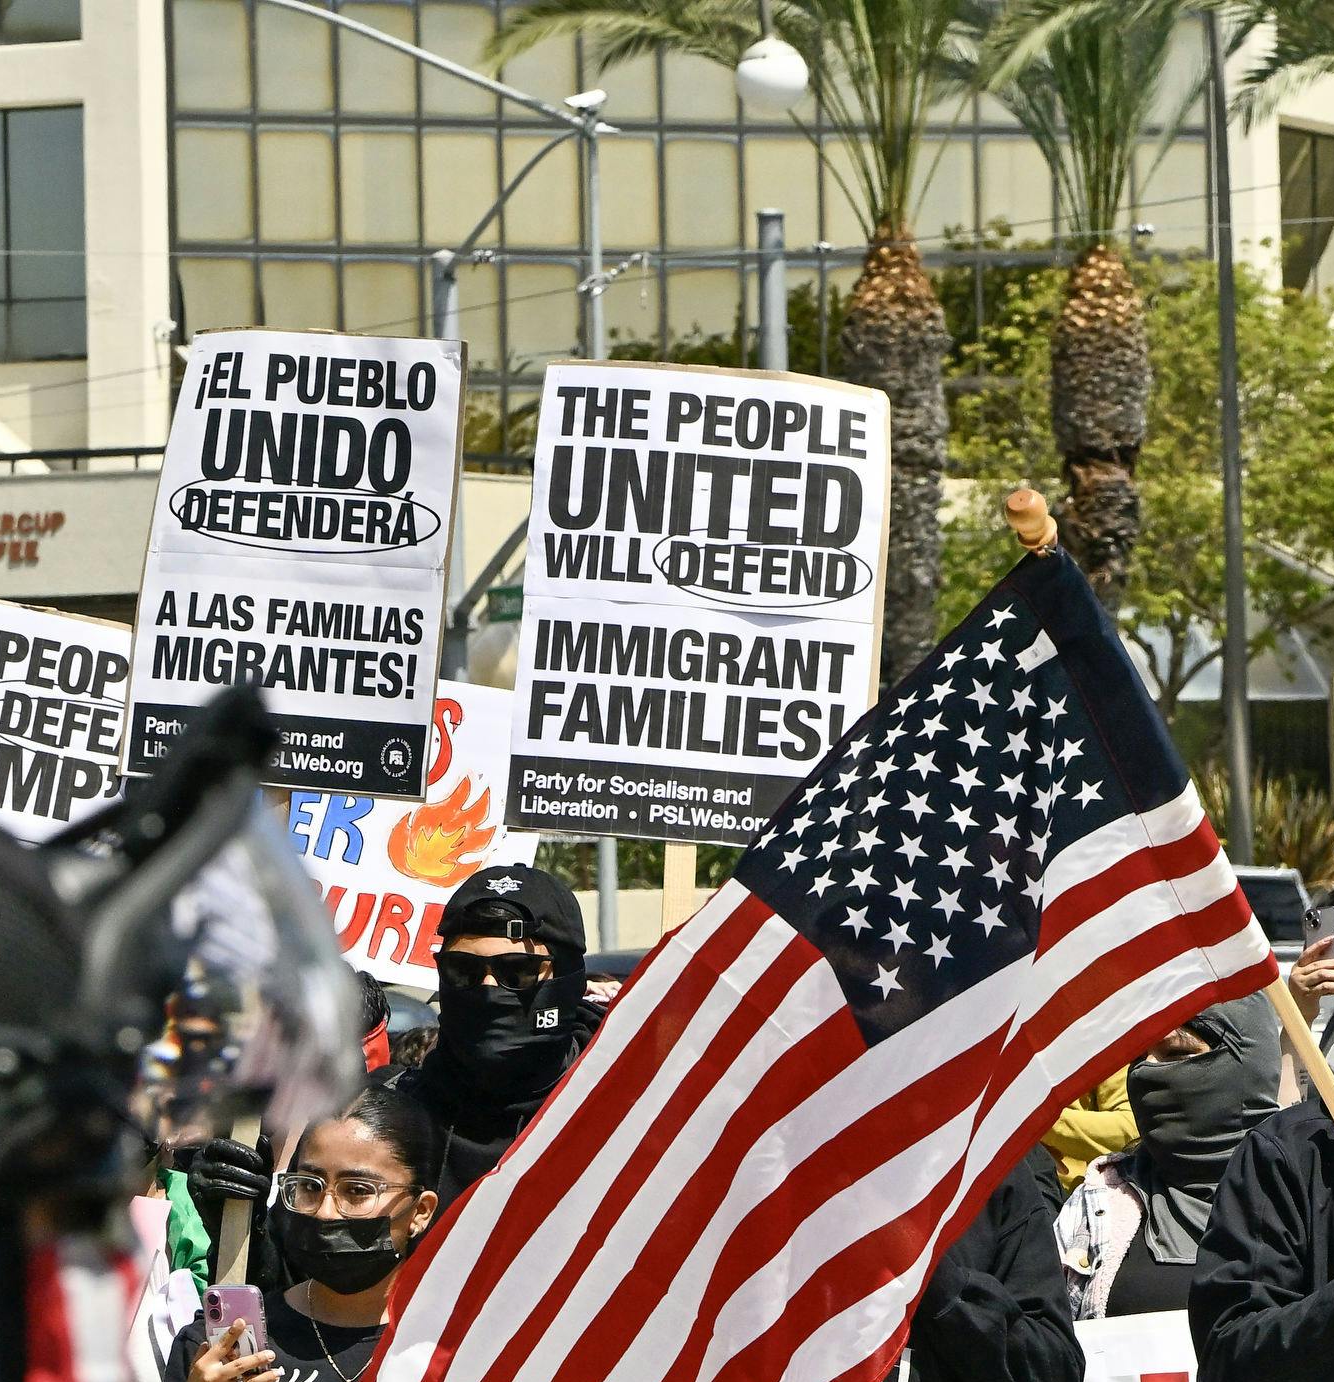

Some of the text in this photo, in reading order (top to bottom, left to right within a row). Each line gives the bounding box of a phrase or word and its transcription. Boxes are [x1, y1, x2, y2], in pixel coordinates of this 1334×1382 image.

[194, 352, 436, 412] ¡EL PUEBLO
[200, 407, 412, 497] UNIDO
[557, 385, 867, 459] THE PEOPLE
[181, 487, 417, 547] DEFENDERÁ
[548, 445, 863, 549] UNITED
[544, 532, 857, 600] WILL DEFEND
[155, 590, 424, 646] A LAS FAMILIAS
[152, 634, 418, 700] MIGRANTES!
[533, 619, 855, 694] IMMIGRANT
[311, 731, 344, 750] and
[526, 680, 845, 762] FAMILIES!
[520, 795, 618, 820] Liberation
[522, 769, 752, 806] Party for Socialism and
